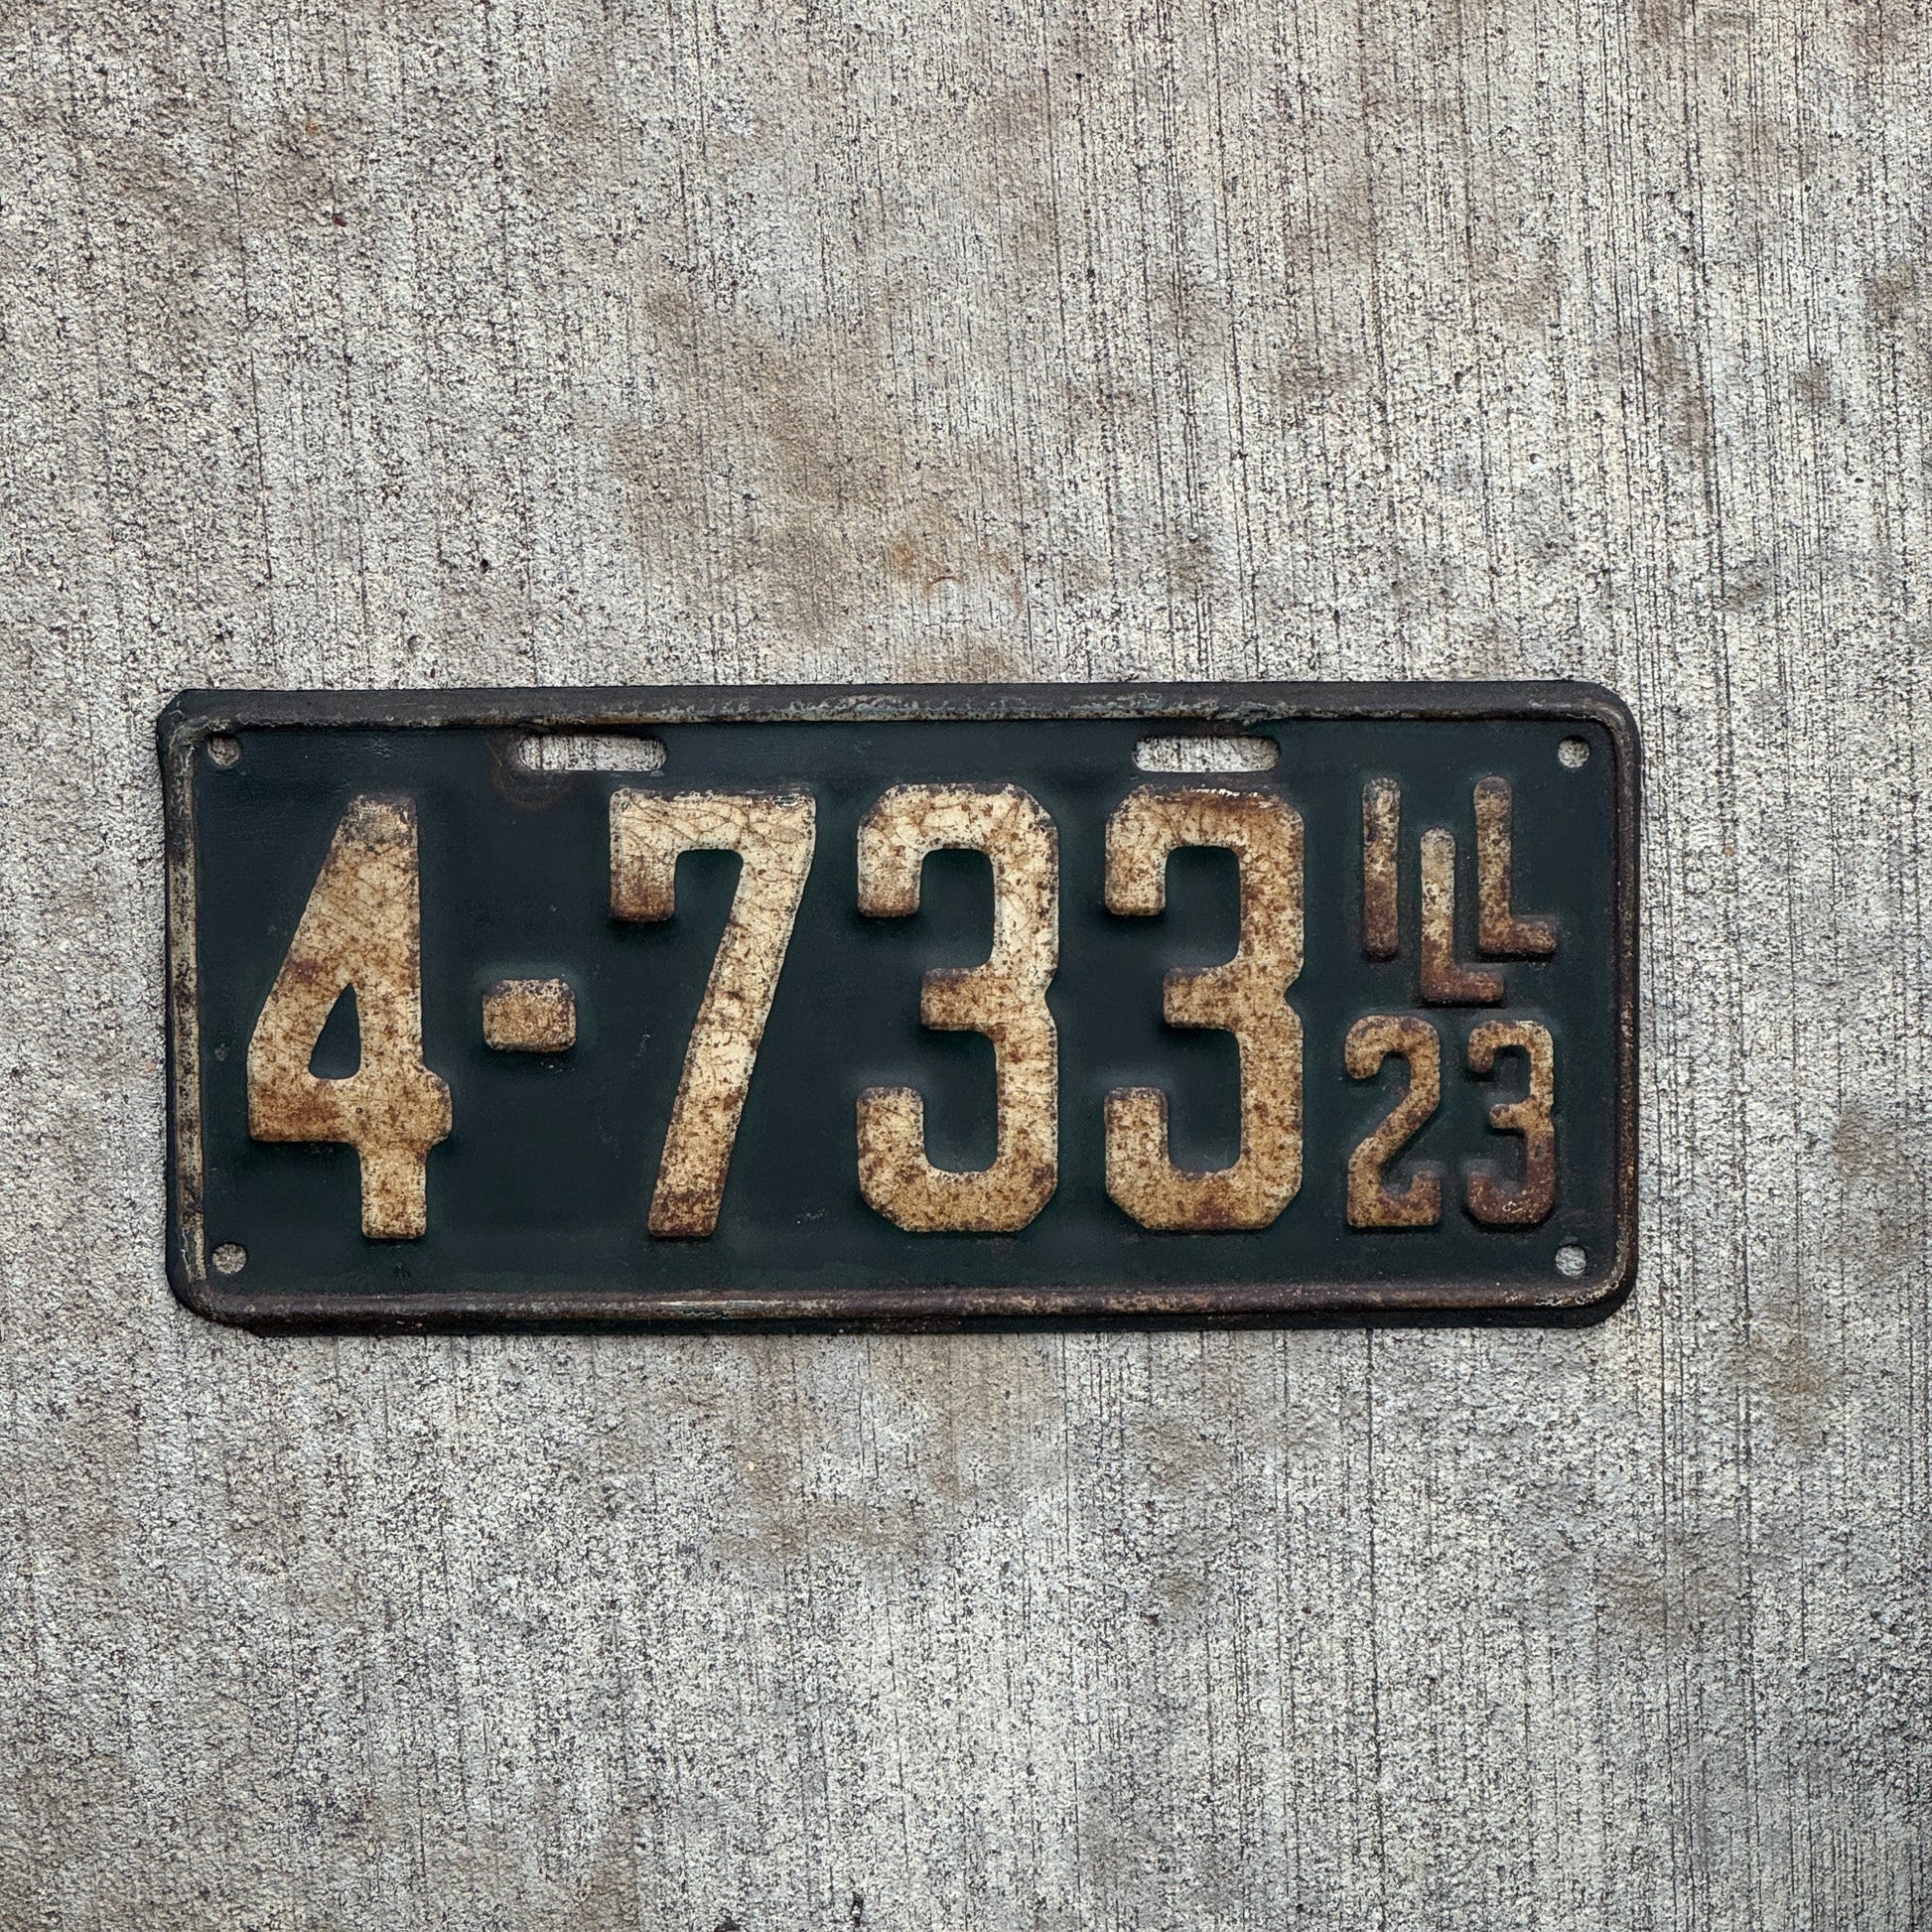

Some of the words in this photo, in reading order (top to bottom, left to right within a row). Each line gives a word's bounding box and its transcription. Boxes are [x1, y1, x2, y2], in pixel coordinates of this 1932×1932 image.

[1362, 775, 1557, 1004] ILL
[247, 783, 1306, 1241] 4-733
[1345, 1017, 1556, 1227] 23
